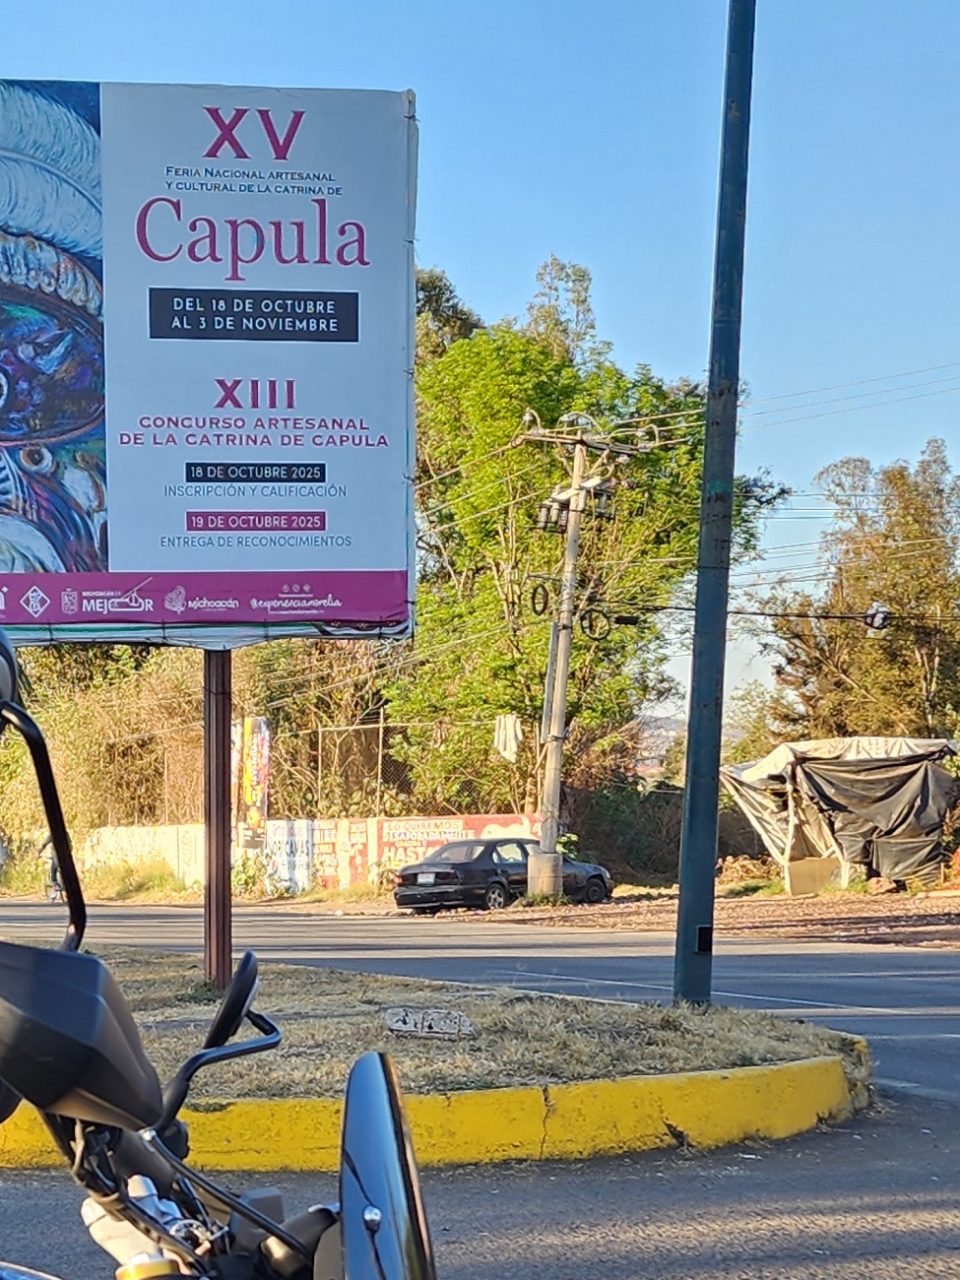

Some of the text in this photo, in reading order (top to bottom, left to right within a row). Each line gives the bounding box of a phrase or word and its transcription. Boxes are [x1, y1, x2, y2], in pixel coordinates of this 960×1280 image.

[202, 106, 306, 160] XV
[165, 166, 336, 182] FERIA NACIONAL ARTESANAL
[165, 181, 343, 196] Y CULTURAL DE LA CATRINA DE
[135, 196, 371, 281] Capula
[173, 297, 336, 314] DEL 18 DE OCTUBRE
[171, 317, 339, 332] AL 3 DE NOVIEMBRE
[214, 378, 296, 410] XIII
[139, 416, 370, 431] CONCURSO ARTESANAL
[119, 433, 389, 448] DE LA CATRINA DE CAPULA
[190, 467, 321, 479] 18 DE OCTUBRE 2025
[164, 483, 347, 498] INSCRIPCIÓN Y CALIFICACIÓN
[191, 516, 321, 528] 19 DE OCTUBRE 2025
[160, 536, 352, 548] ENTREGA DE RECONOCIMIENTOS
